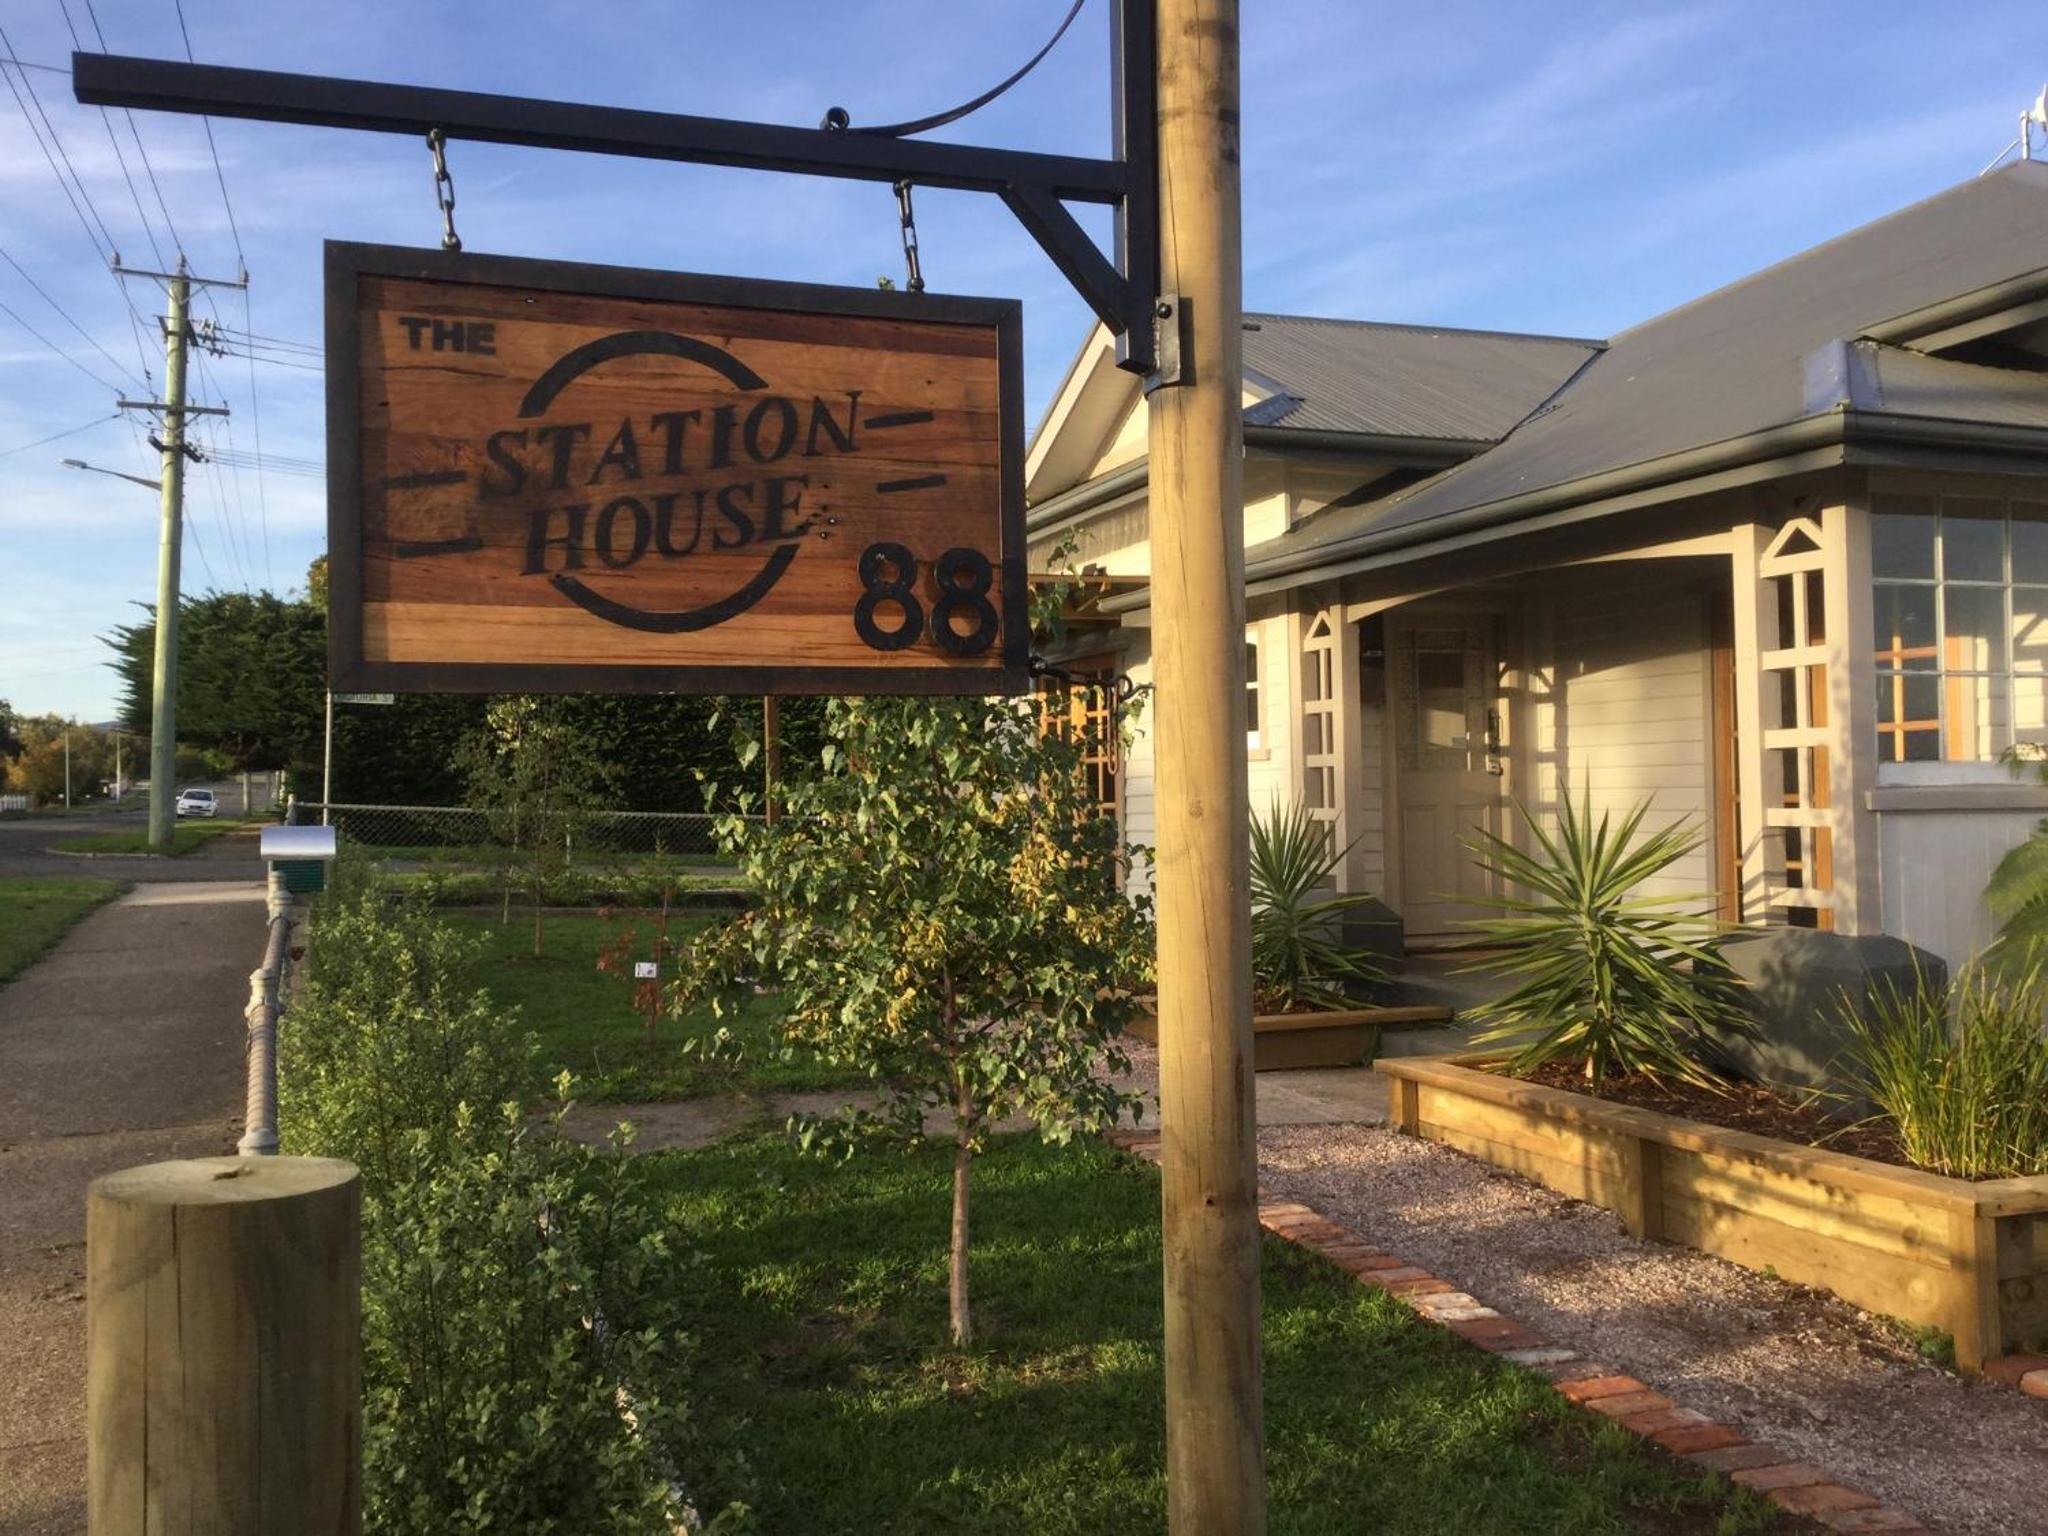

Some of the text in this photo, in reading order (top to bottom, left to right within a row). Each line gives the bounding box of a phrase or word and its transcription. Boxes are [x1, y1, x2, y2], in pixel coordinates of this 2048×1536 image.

[400, 317, 496, 356] THE
[482, 389, 862, 499] STATION
[522, 475, 814, 576] HOUSE
[854, 542, 999, 655] 88
